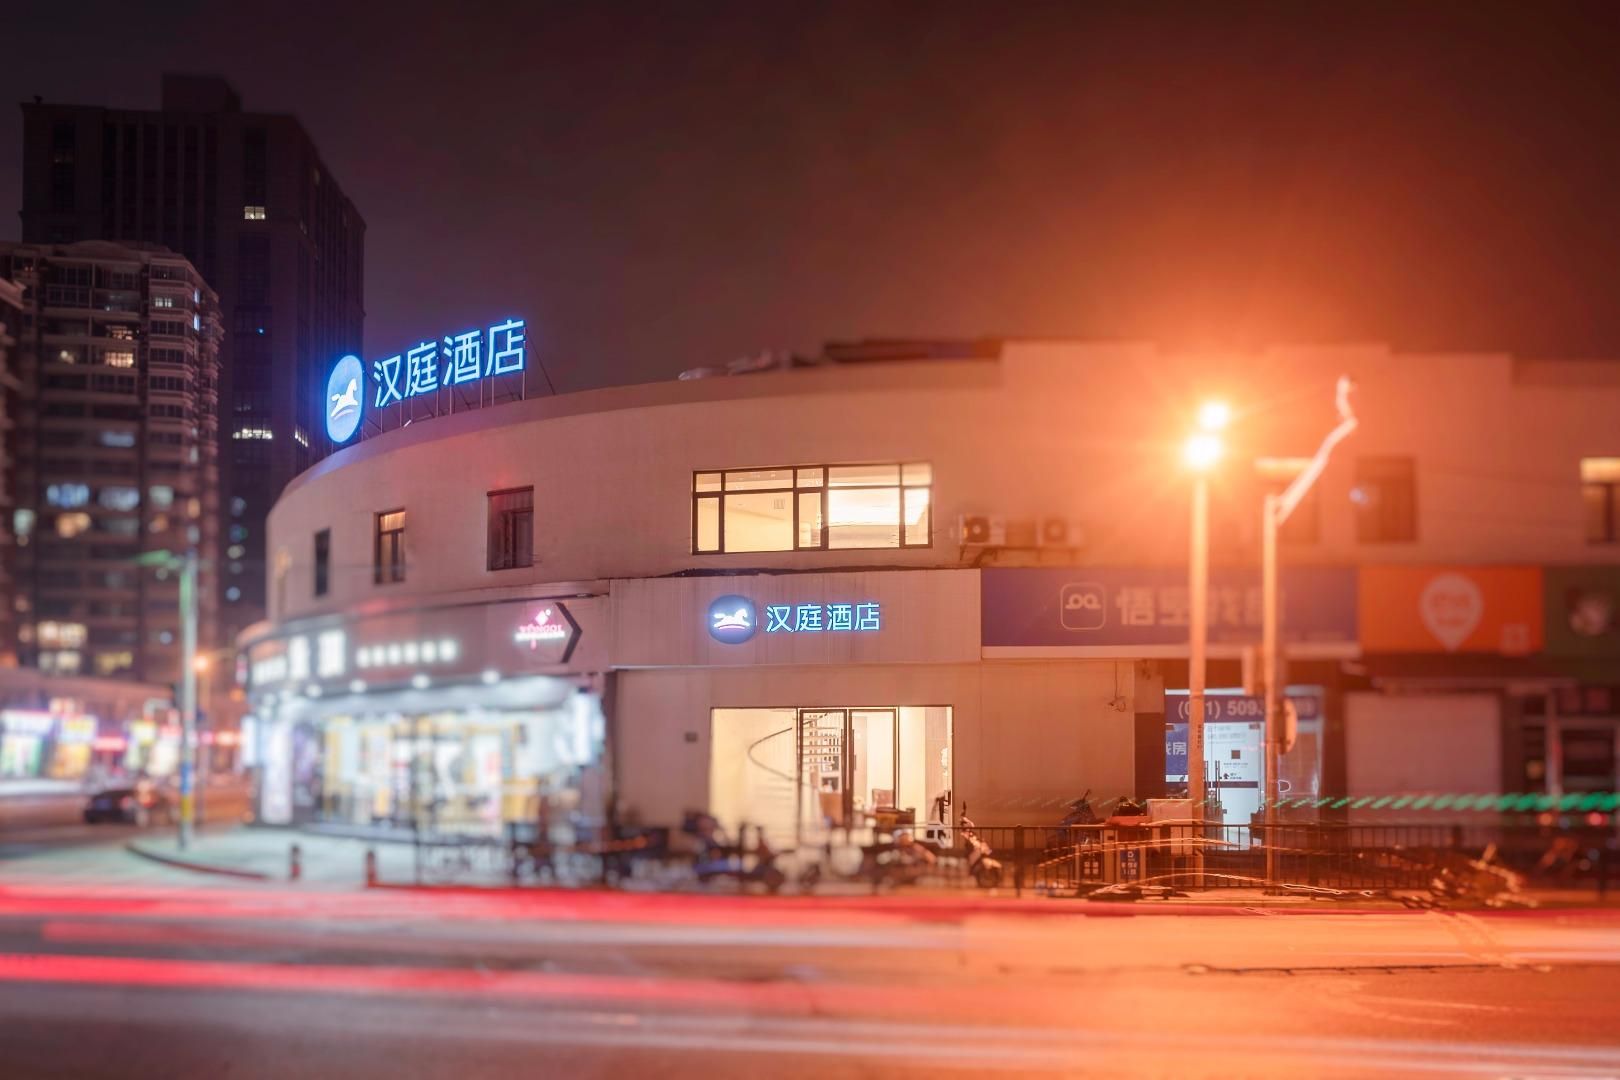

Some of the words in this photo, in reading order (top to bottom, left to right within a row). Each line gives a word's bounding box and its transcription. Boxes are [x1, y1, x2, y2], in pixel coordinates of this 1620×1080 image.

[373, 319, 525, 408] 汉庭酒店
[765, 602, 881, 633] 汉庭酒店
[1177, 700, 1221, 719] (01)
